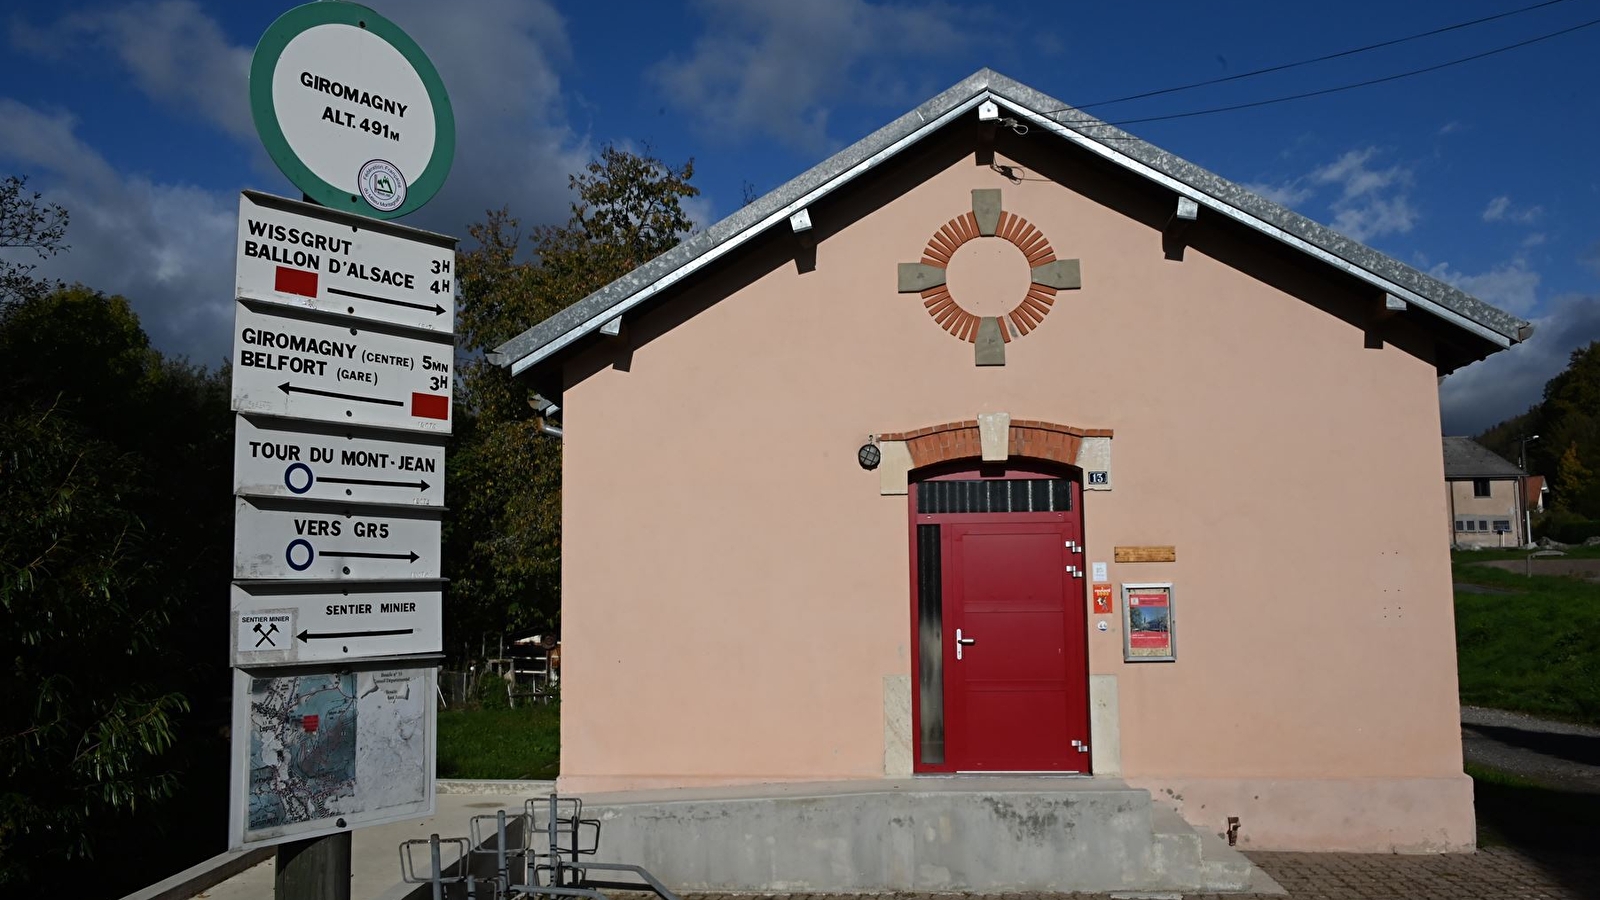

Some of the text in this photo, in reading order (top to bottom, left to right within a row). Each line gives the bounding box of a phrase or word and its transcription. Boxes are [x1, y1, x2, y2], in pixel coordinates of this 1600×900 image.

[300, 71, 408, 118] GIROMAGNY
[321, 106, 356, 129] ALT.
[248, 219, 353, 256] WISSGRUT
[244, 240, 415, 290] BALLON D'ALSACE
[430, 259, 450, 274] 3H
[429, 279, 450, 294] 4H
[241, 327, 357, 359] GIROMAGNY
[361, 350, 415, 371] (CENTRE)
[240, 350, 378, 386] BELFORT (GARE)
[429, 375, 448, 391] 3H
[249, 441, 300, 461] TOUR
[309, 447, 334, 464] DU
[1092, 473, 1104, 483] 13
[294, 519, 389, 539] VERS GR5
[325, 602, 416, 616] SENTIER MINIER
